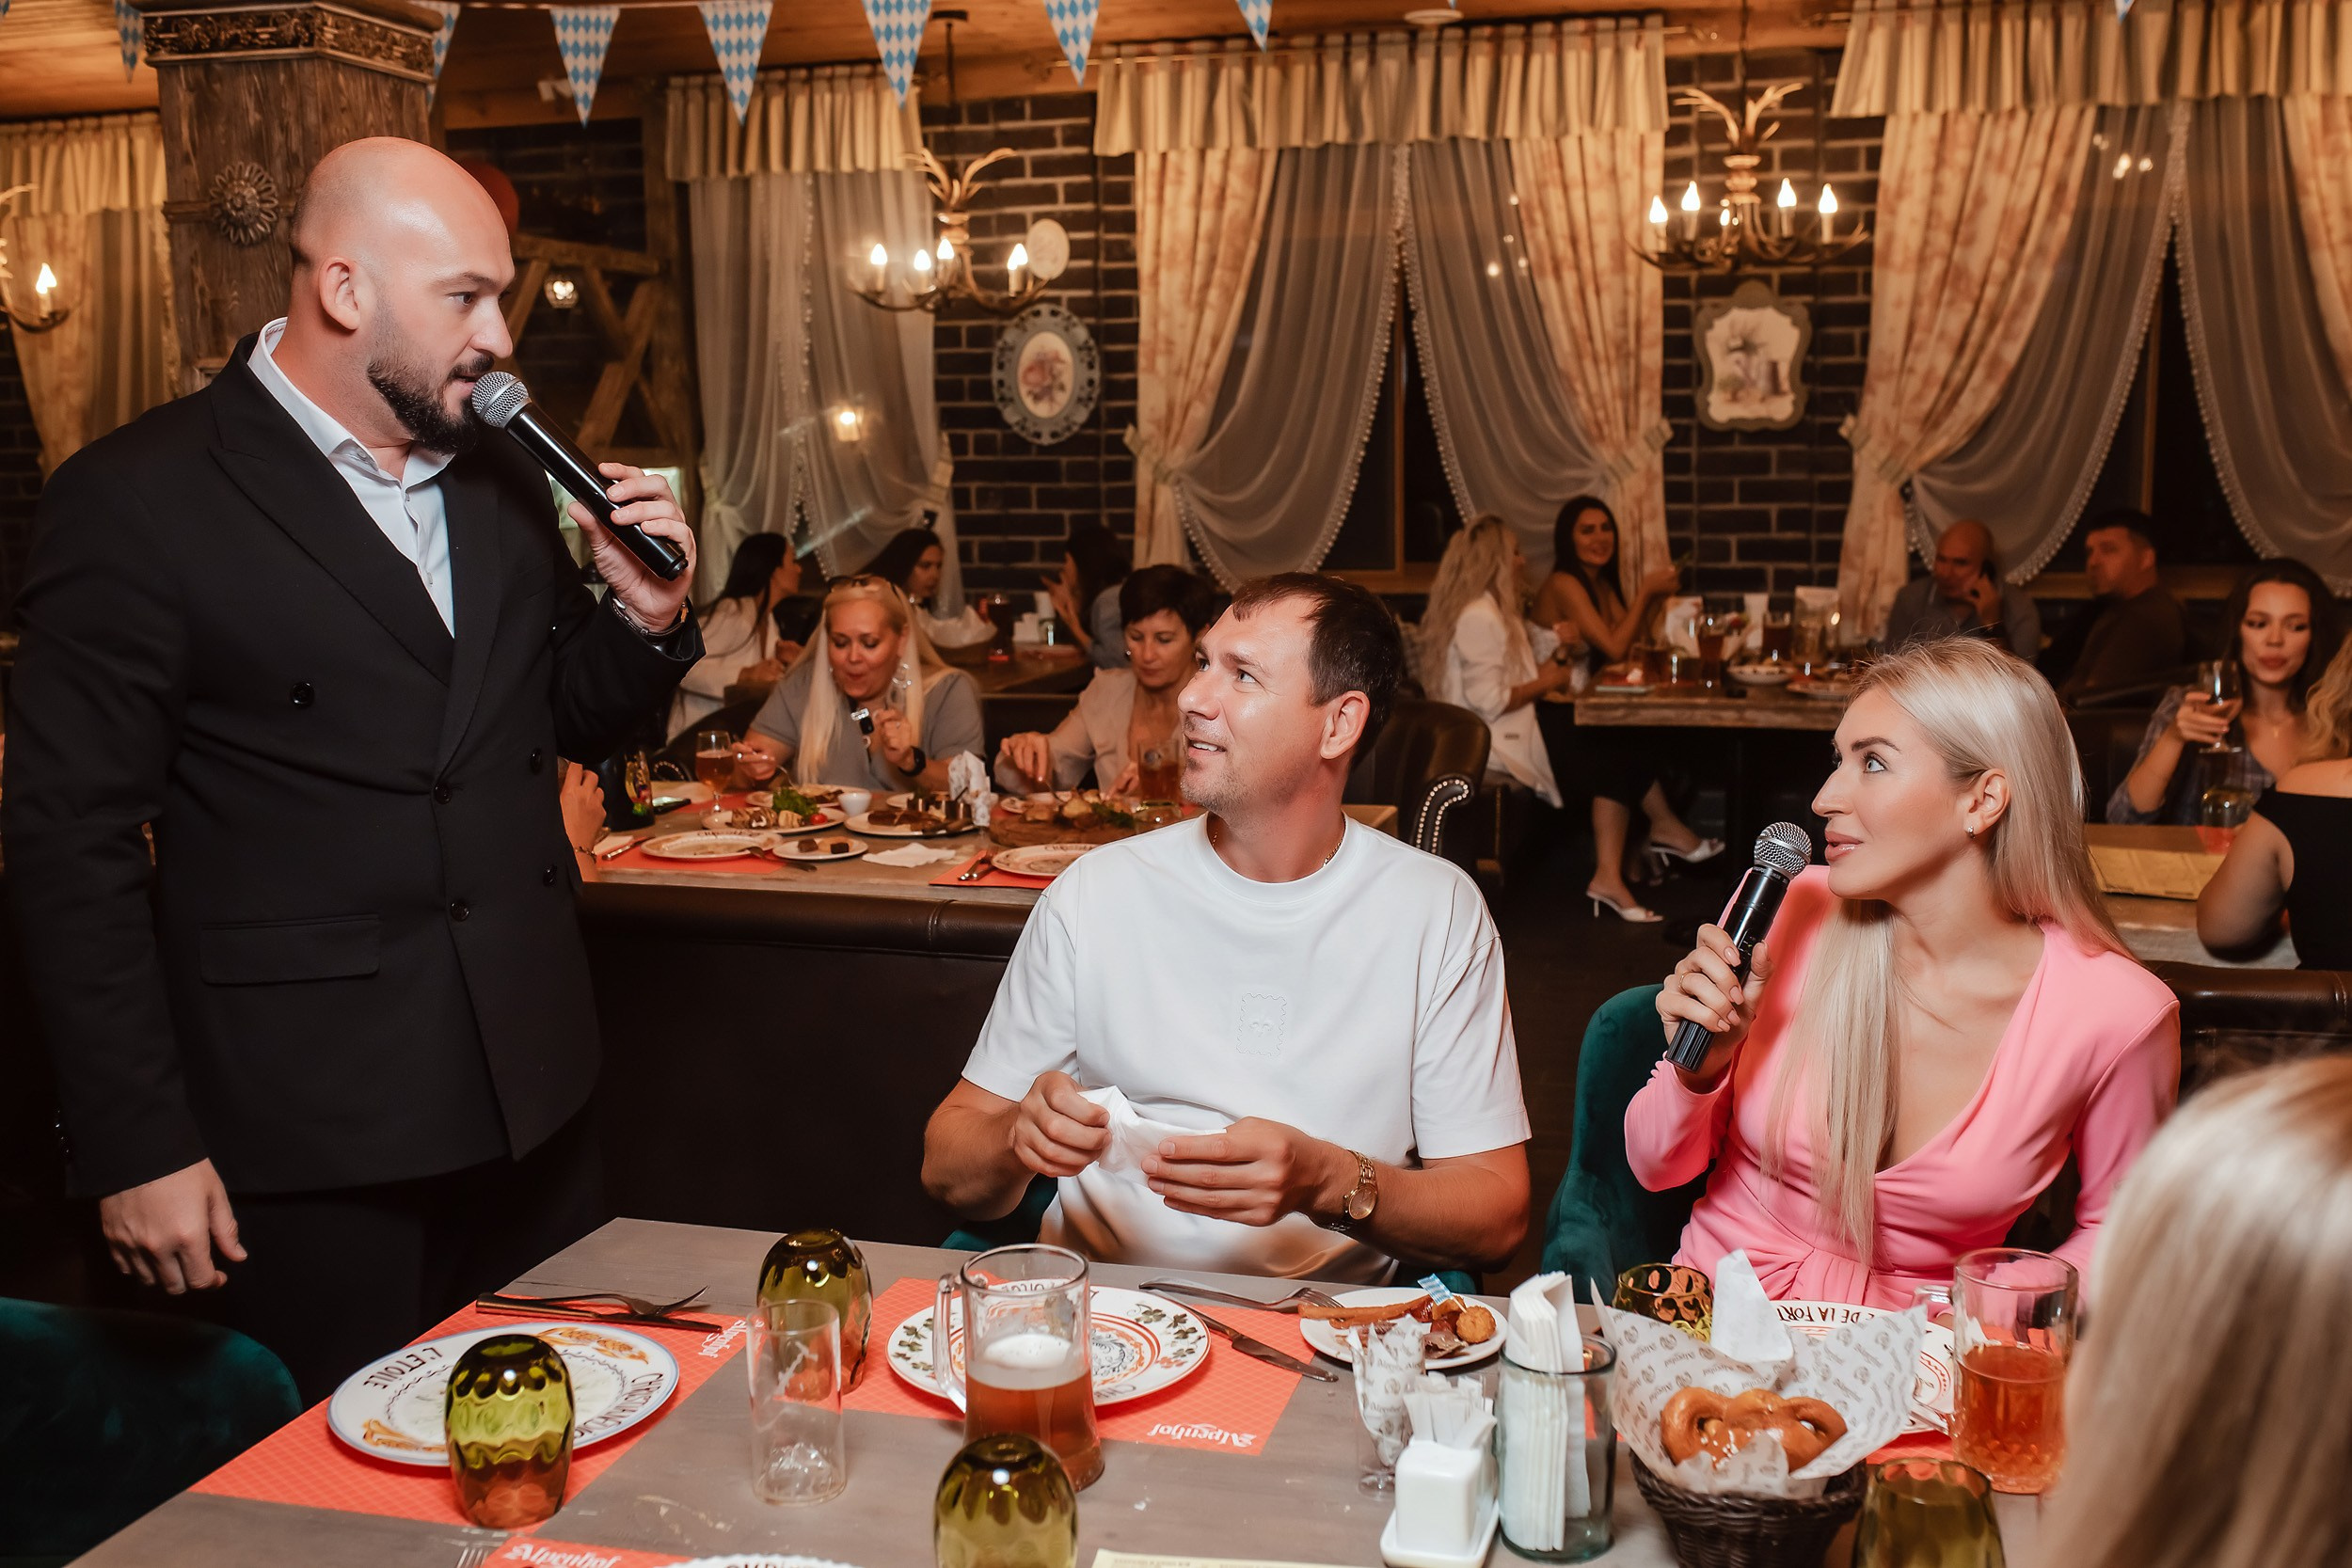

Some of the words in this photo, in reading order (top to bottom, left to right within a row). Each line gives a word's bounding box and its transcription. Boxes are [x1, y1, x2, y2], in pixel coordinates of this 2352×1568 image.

[1818, 1306, 1836, 1323] LA
[1147, 1422, 1257, 1448] Alpenhof
[503, 1543, 623, 1568] Alpenhof
